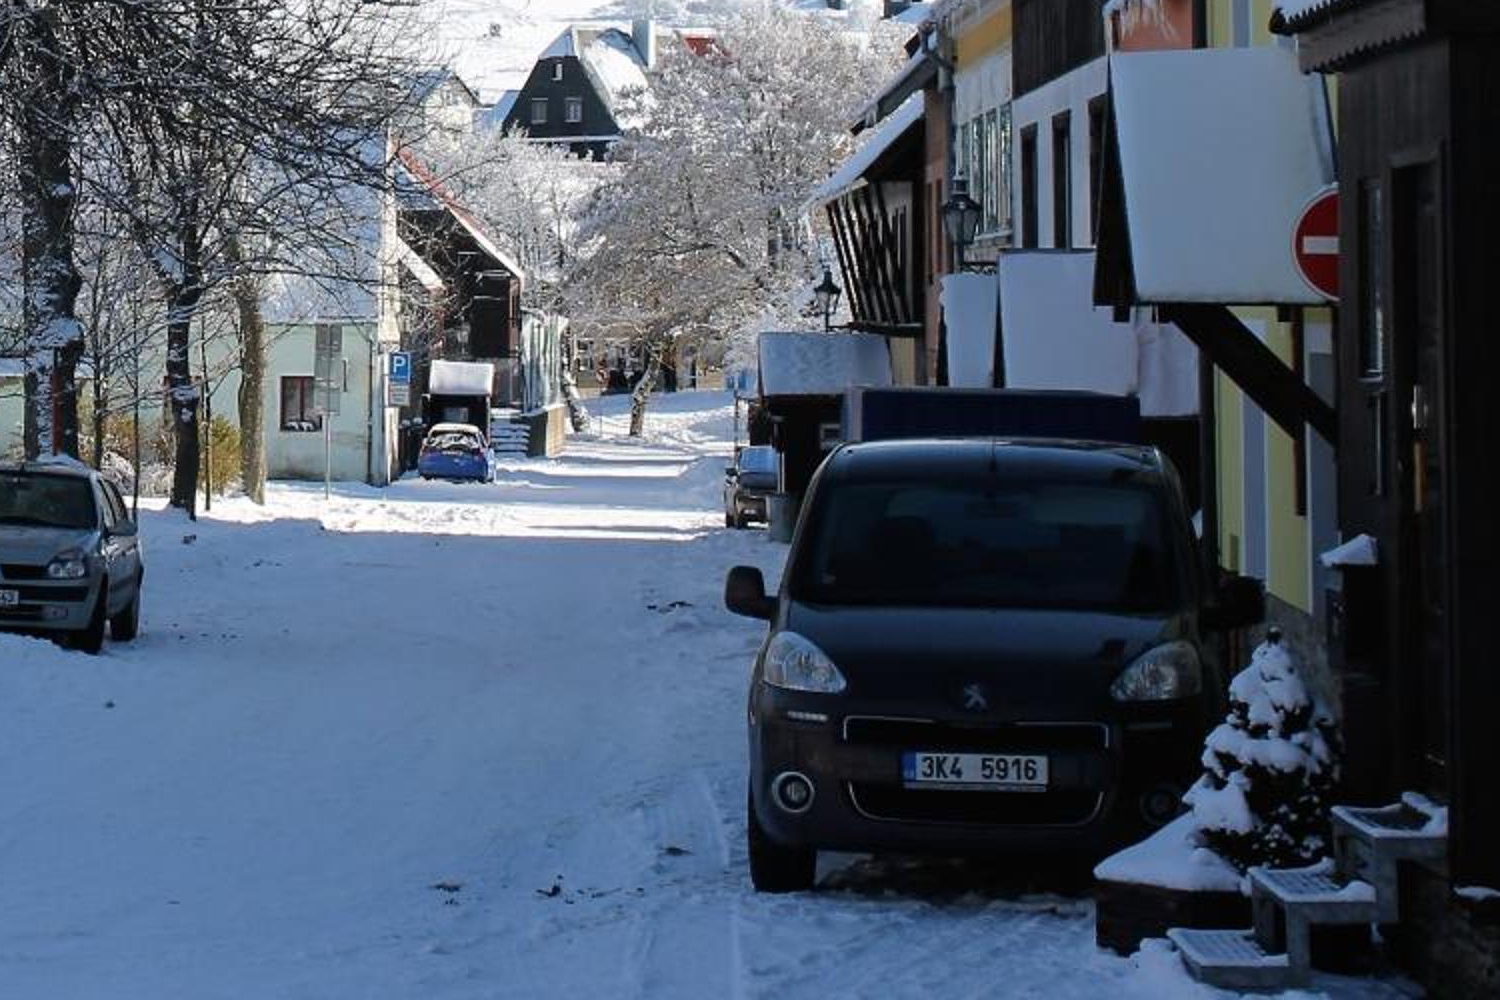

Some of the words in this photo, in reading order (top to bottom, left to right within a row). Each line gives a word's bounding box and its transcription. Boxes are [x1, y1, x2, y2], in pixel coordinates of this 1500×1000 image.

[393, 355, 406, 373] P
[921, 755, 963, 779] 3K4
[981, 757, 1037, 780] 5916
